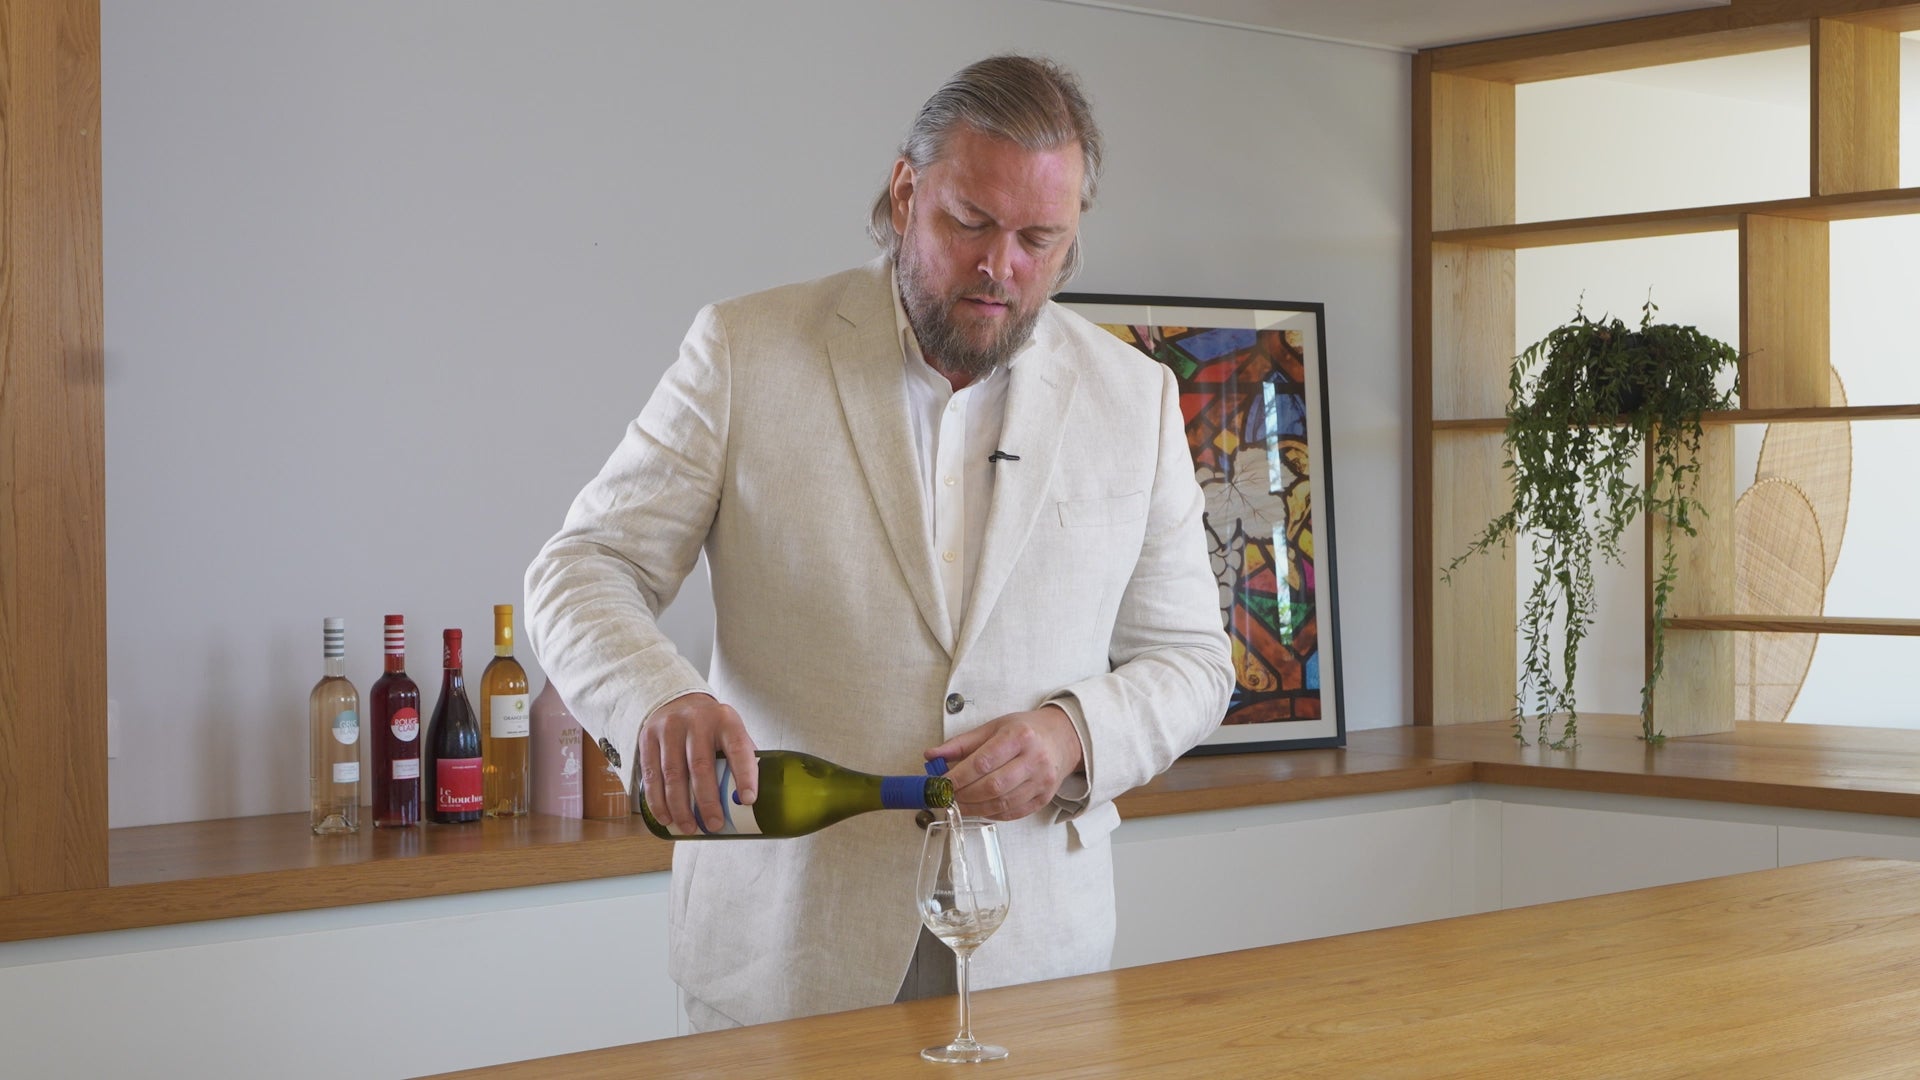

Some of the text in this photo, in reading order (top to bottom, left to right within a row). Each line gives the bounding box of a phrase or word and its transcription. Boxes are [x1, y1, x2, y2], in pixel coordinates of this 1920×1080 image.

[339, 720, 357, 728] GRIS
[394, 718, 418, 726] ROUGE
[440, 787, 452, 796] Le
